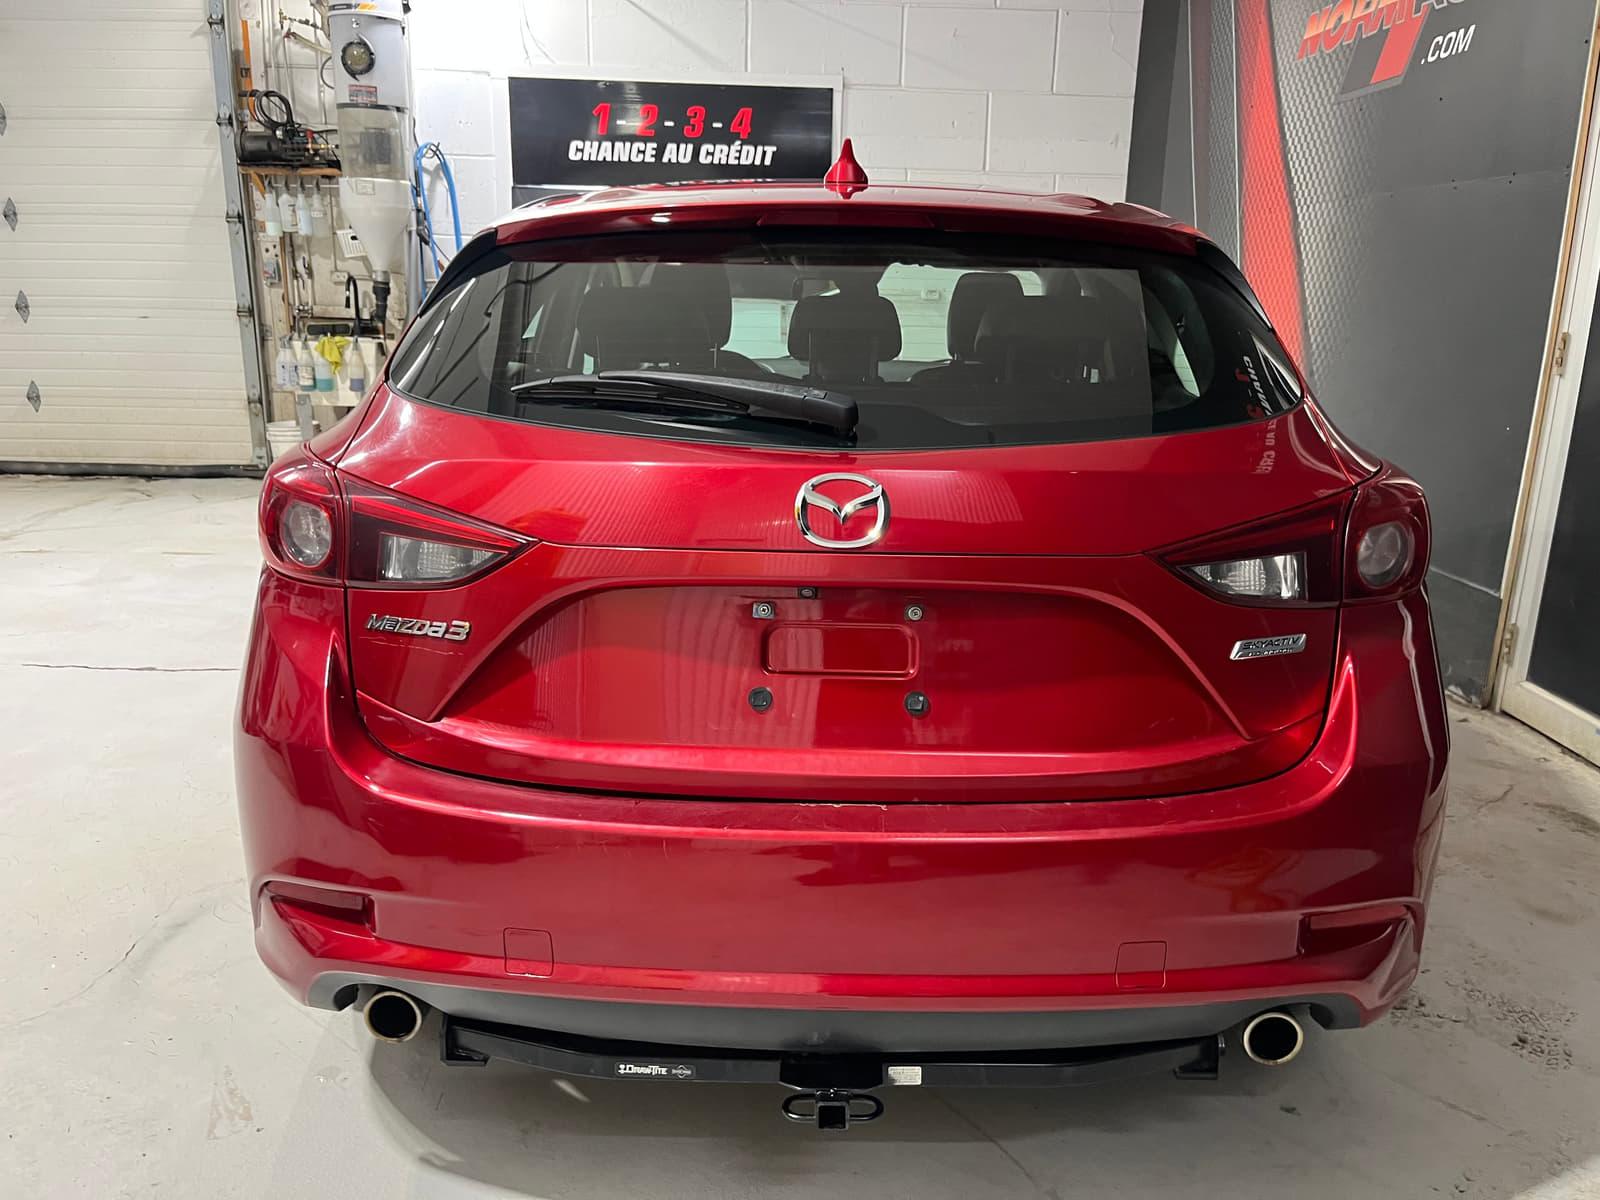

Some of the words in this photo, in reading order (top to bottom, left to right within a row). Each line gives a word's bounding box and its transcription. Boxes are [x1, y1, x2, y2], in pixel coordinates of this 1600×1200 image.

[1420, 24, 1476, 65] .COM
[568, 140, 658, 163] CHANCE
[662, 143, 694, 164] AU
[699, 140, 777, 166] CRÉDIT
[1243, 635, 1301, 650] SKYACTIV
